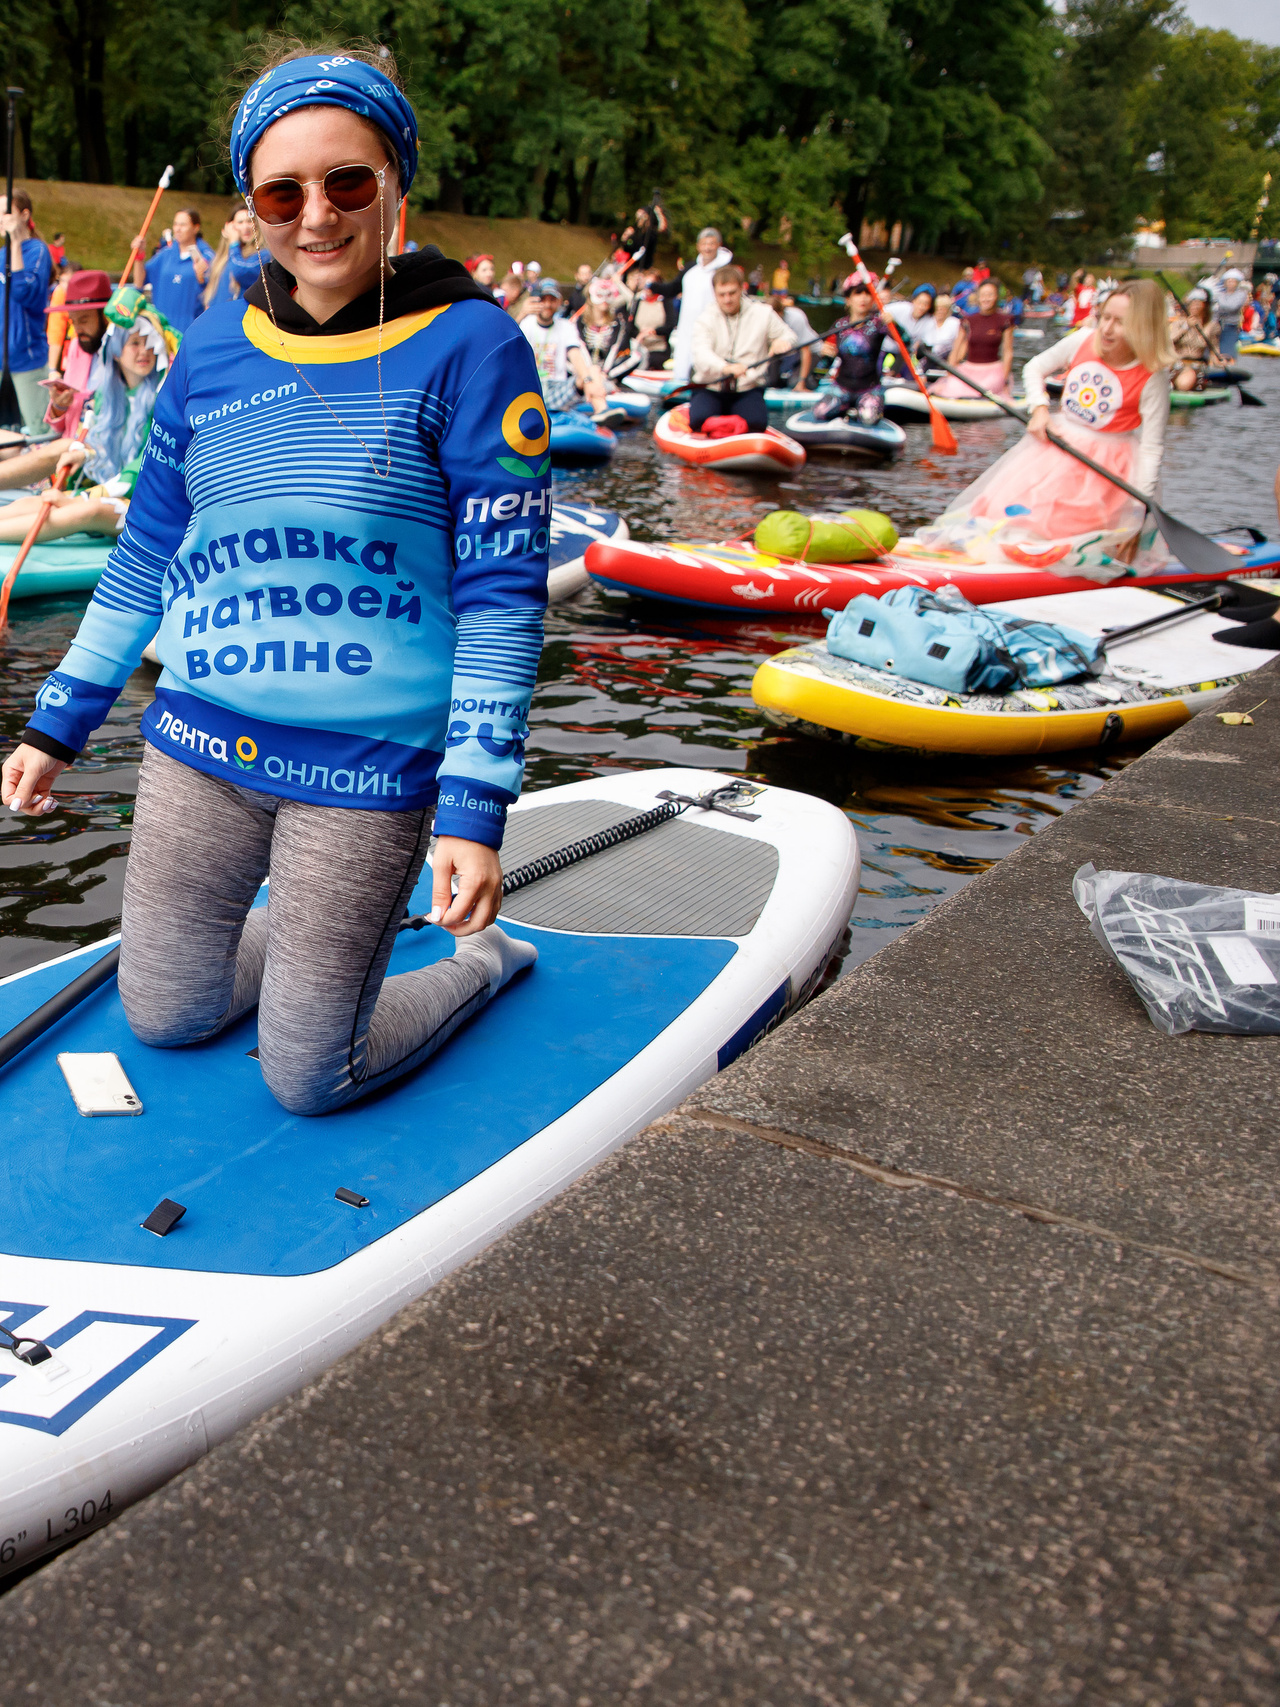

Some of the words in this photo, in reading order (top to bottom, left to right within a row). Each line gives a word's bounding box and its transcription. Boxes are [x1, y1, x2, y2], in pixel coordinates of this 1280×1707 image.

[189, 381, 298, 430] lenta.com
[167, 527, 398, 613] Доставка
[186, 640, 373, 680] волне
[156, 710, 229, 763] лента
[264, 755, 402, 797] онлайн
[46, 1488, 114, 1543] L304
